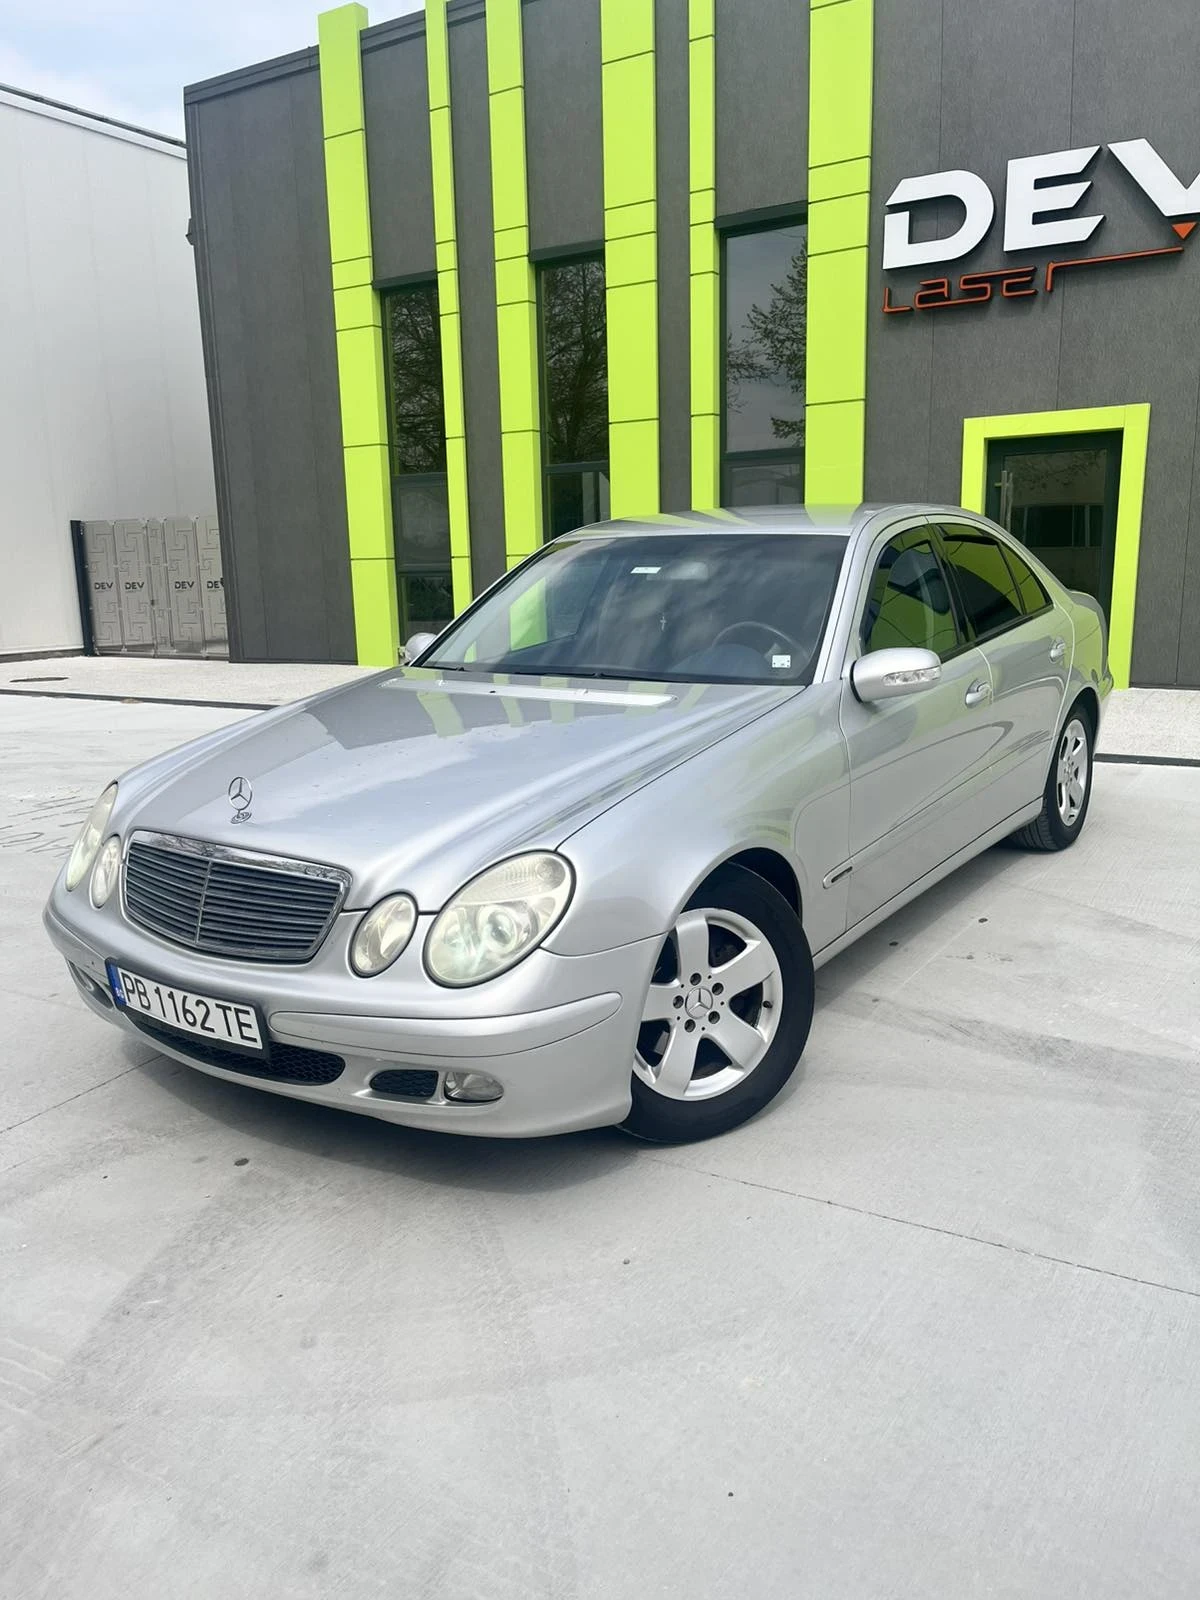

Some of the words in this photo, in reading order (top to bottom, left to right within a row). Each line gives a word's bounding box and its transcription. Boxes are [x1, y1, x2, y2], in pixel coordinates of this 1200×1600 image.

[883, 138, 1200, 269] DEV
[94, 582, 114, 590] DEV
[125, 582, 145, 590] DEV
[174, 581, 195, 590] DEV
